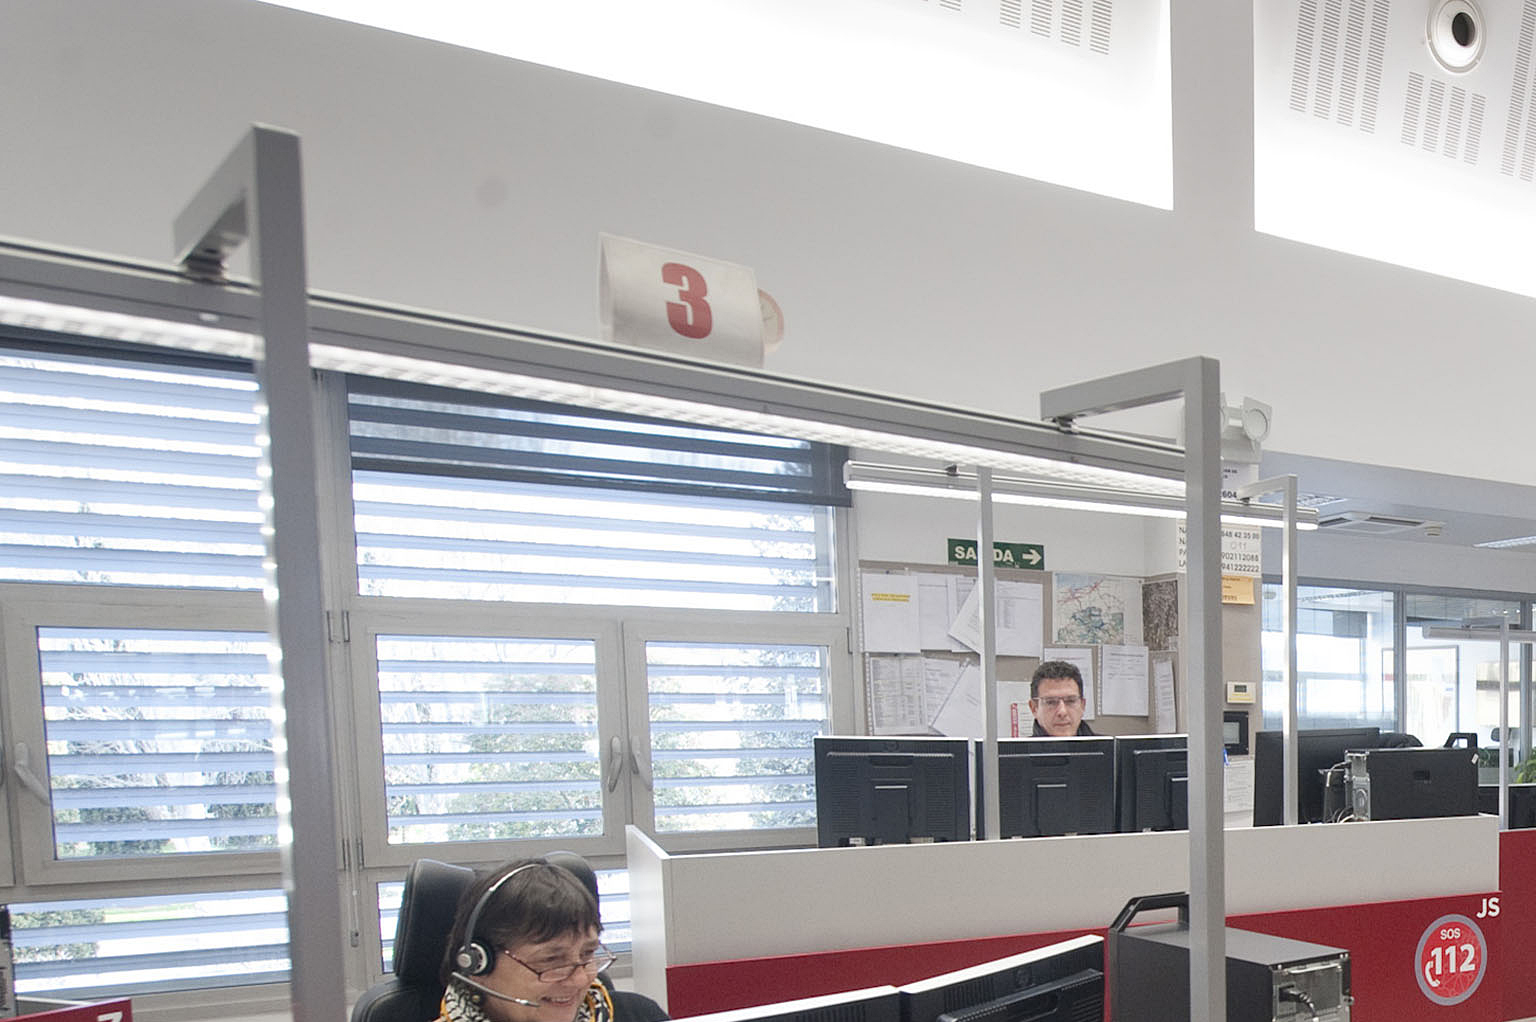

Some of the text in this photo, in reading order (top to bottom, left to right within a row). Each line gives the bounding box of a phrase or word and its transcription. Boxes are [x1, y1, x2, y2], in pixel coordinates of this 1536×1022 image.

[661, 262, 713, 340] 3
[954, 545, 1014, 562] SADA
[1476, 897, 1500, 918] JS
[1440, 927, 1461, 940] SOS
[1430, 944, 1476, 975] 112
